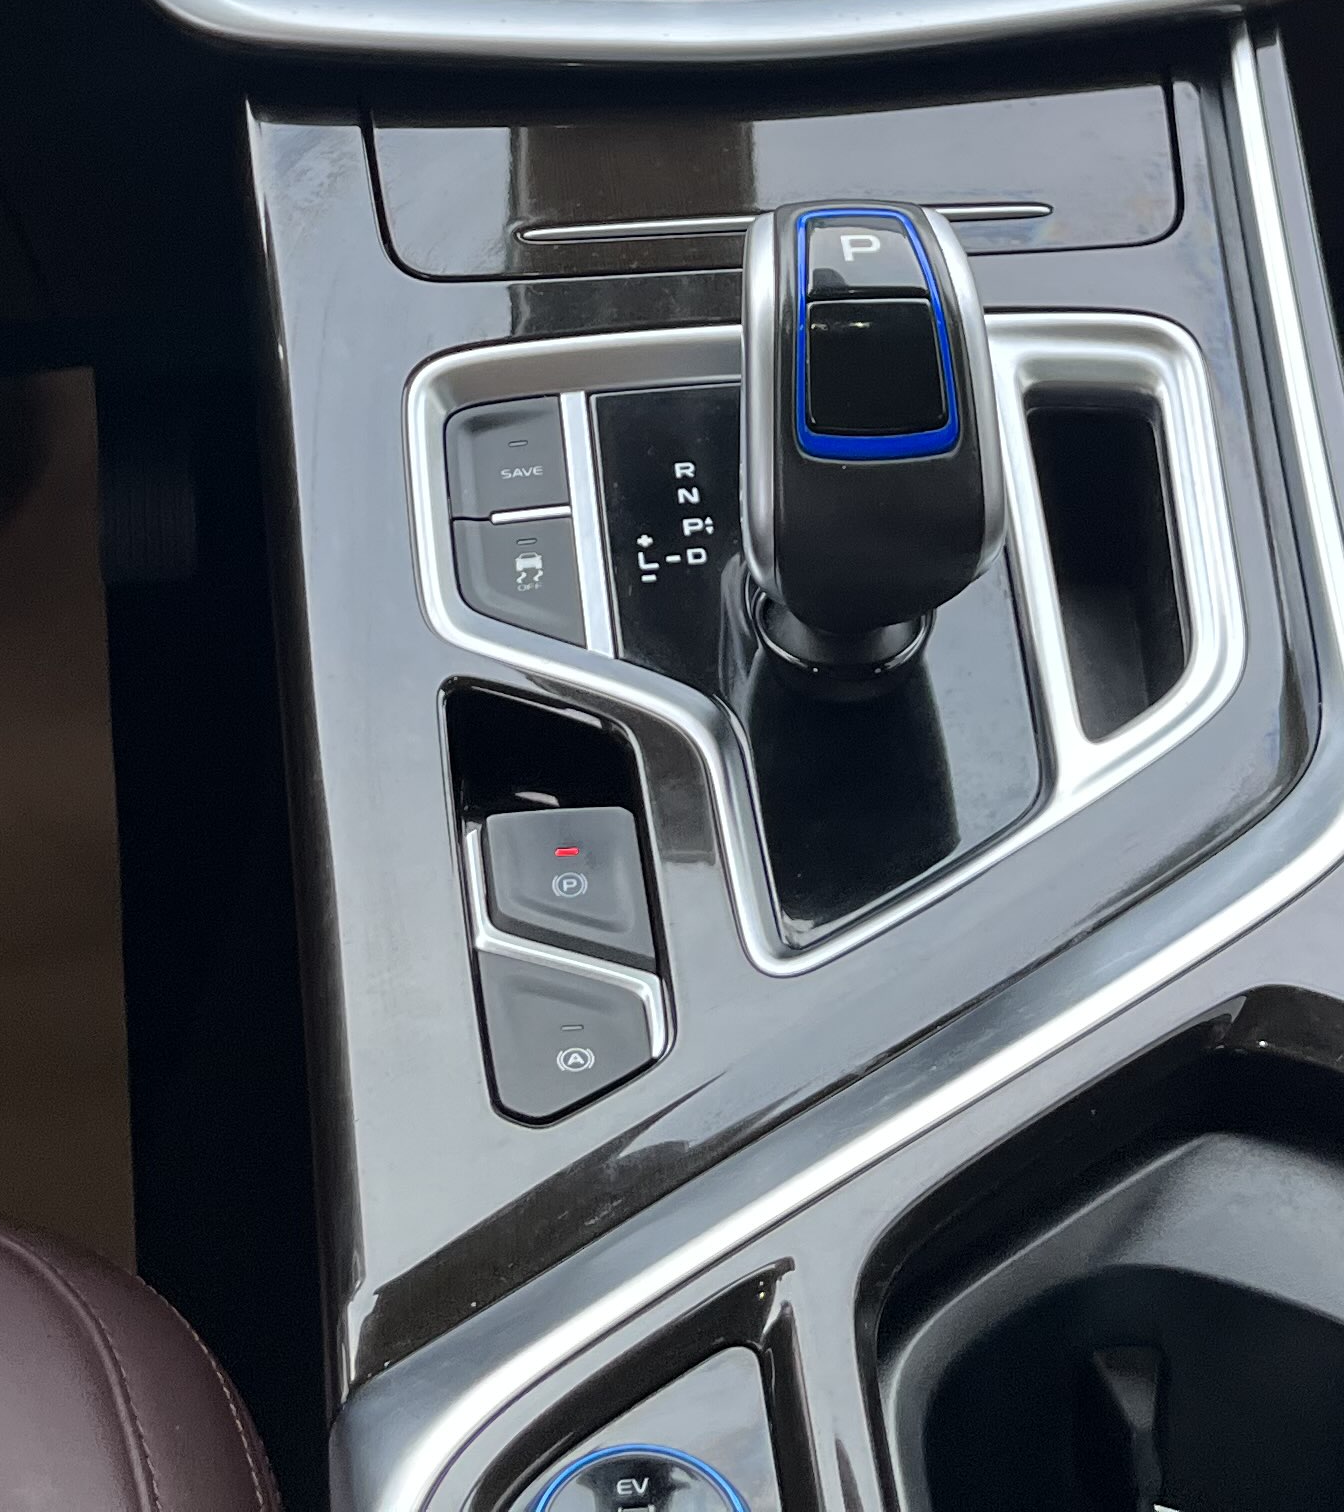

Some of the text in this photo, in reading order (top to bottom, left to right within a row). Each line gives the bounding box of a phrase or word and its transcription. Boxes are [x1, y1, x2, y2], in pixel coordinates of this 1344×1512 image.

[839, 233, 882, 263] P
[500, 465, 544, 480] SAVE
[674, 461, 696, 479] R
[677, 486, 701, 504] N
[682, 517, 704, 537] P
[517, 583, 544, 593] OFF
[616, 1477, 650, 1497] EV
